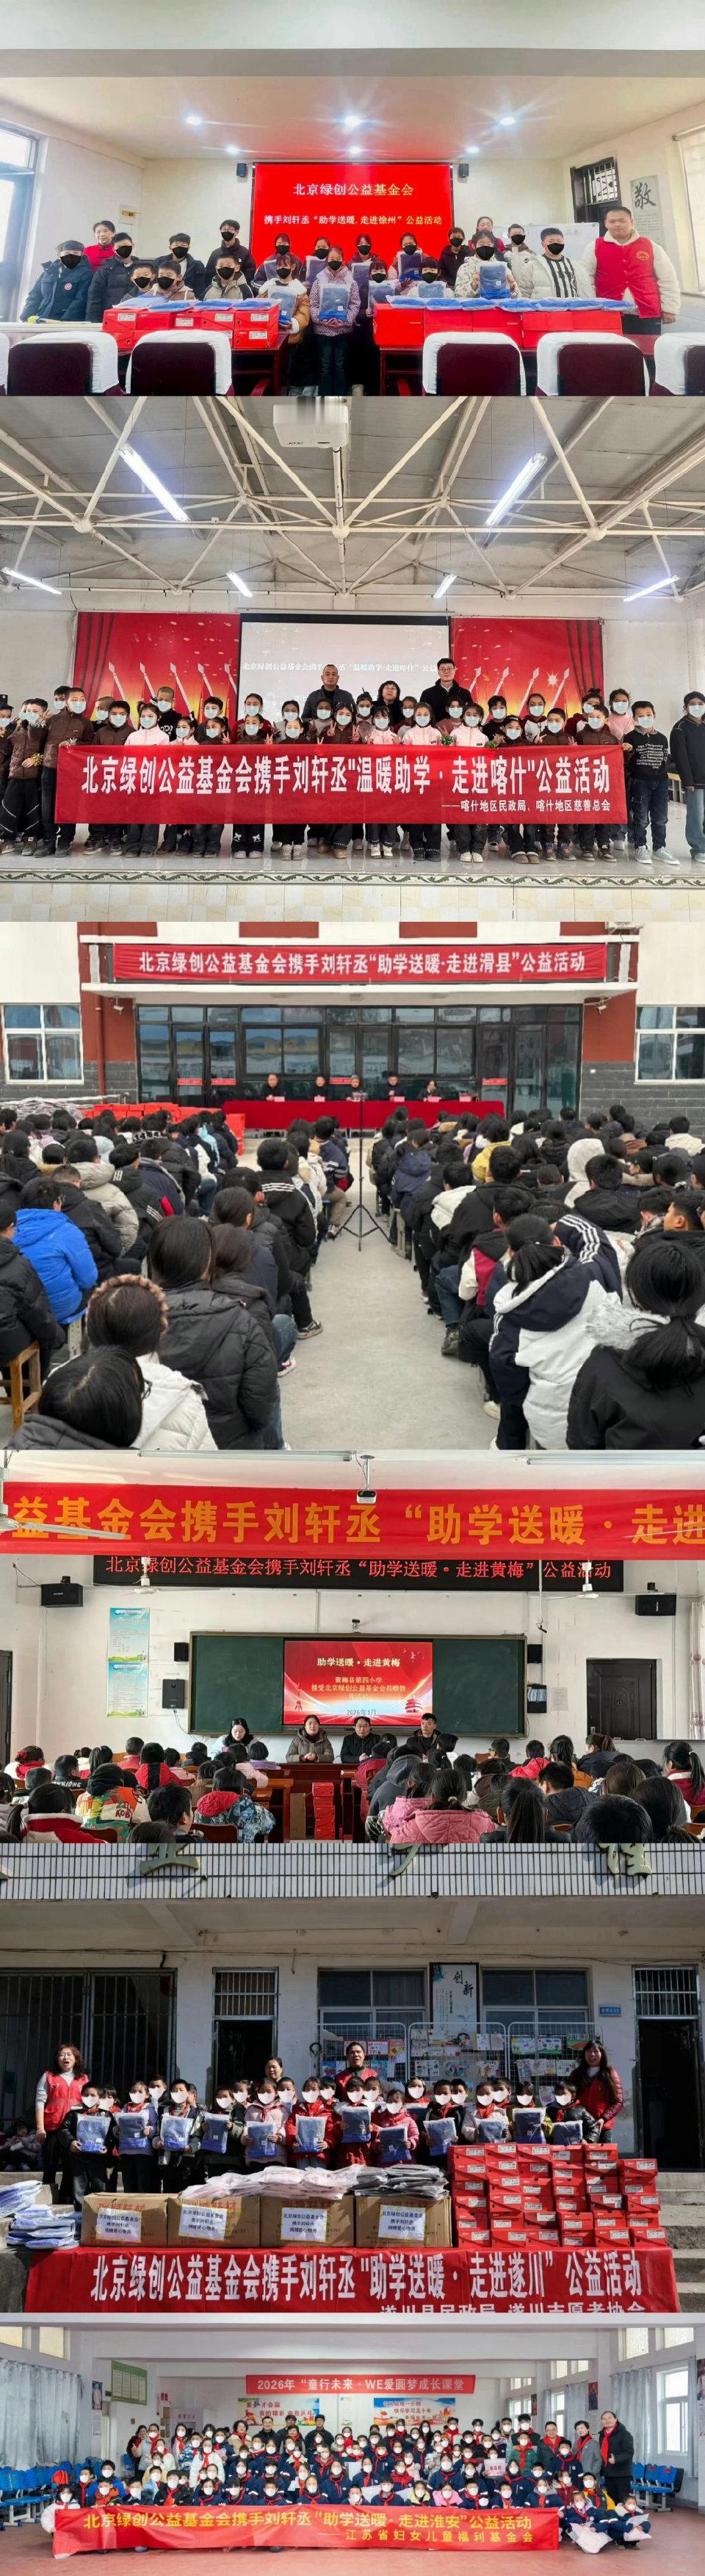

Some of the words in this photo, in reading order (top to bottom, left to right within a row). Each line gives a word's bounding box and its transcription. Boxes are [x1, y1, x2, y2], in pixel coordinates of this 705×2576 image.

[293, 183, 414, 196] 北京绿创公益基金会
[634, 182, 657, 210] 敬
